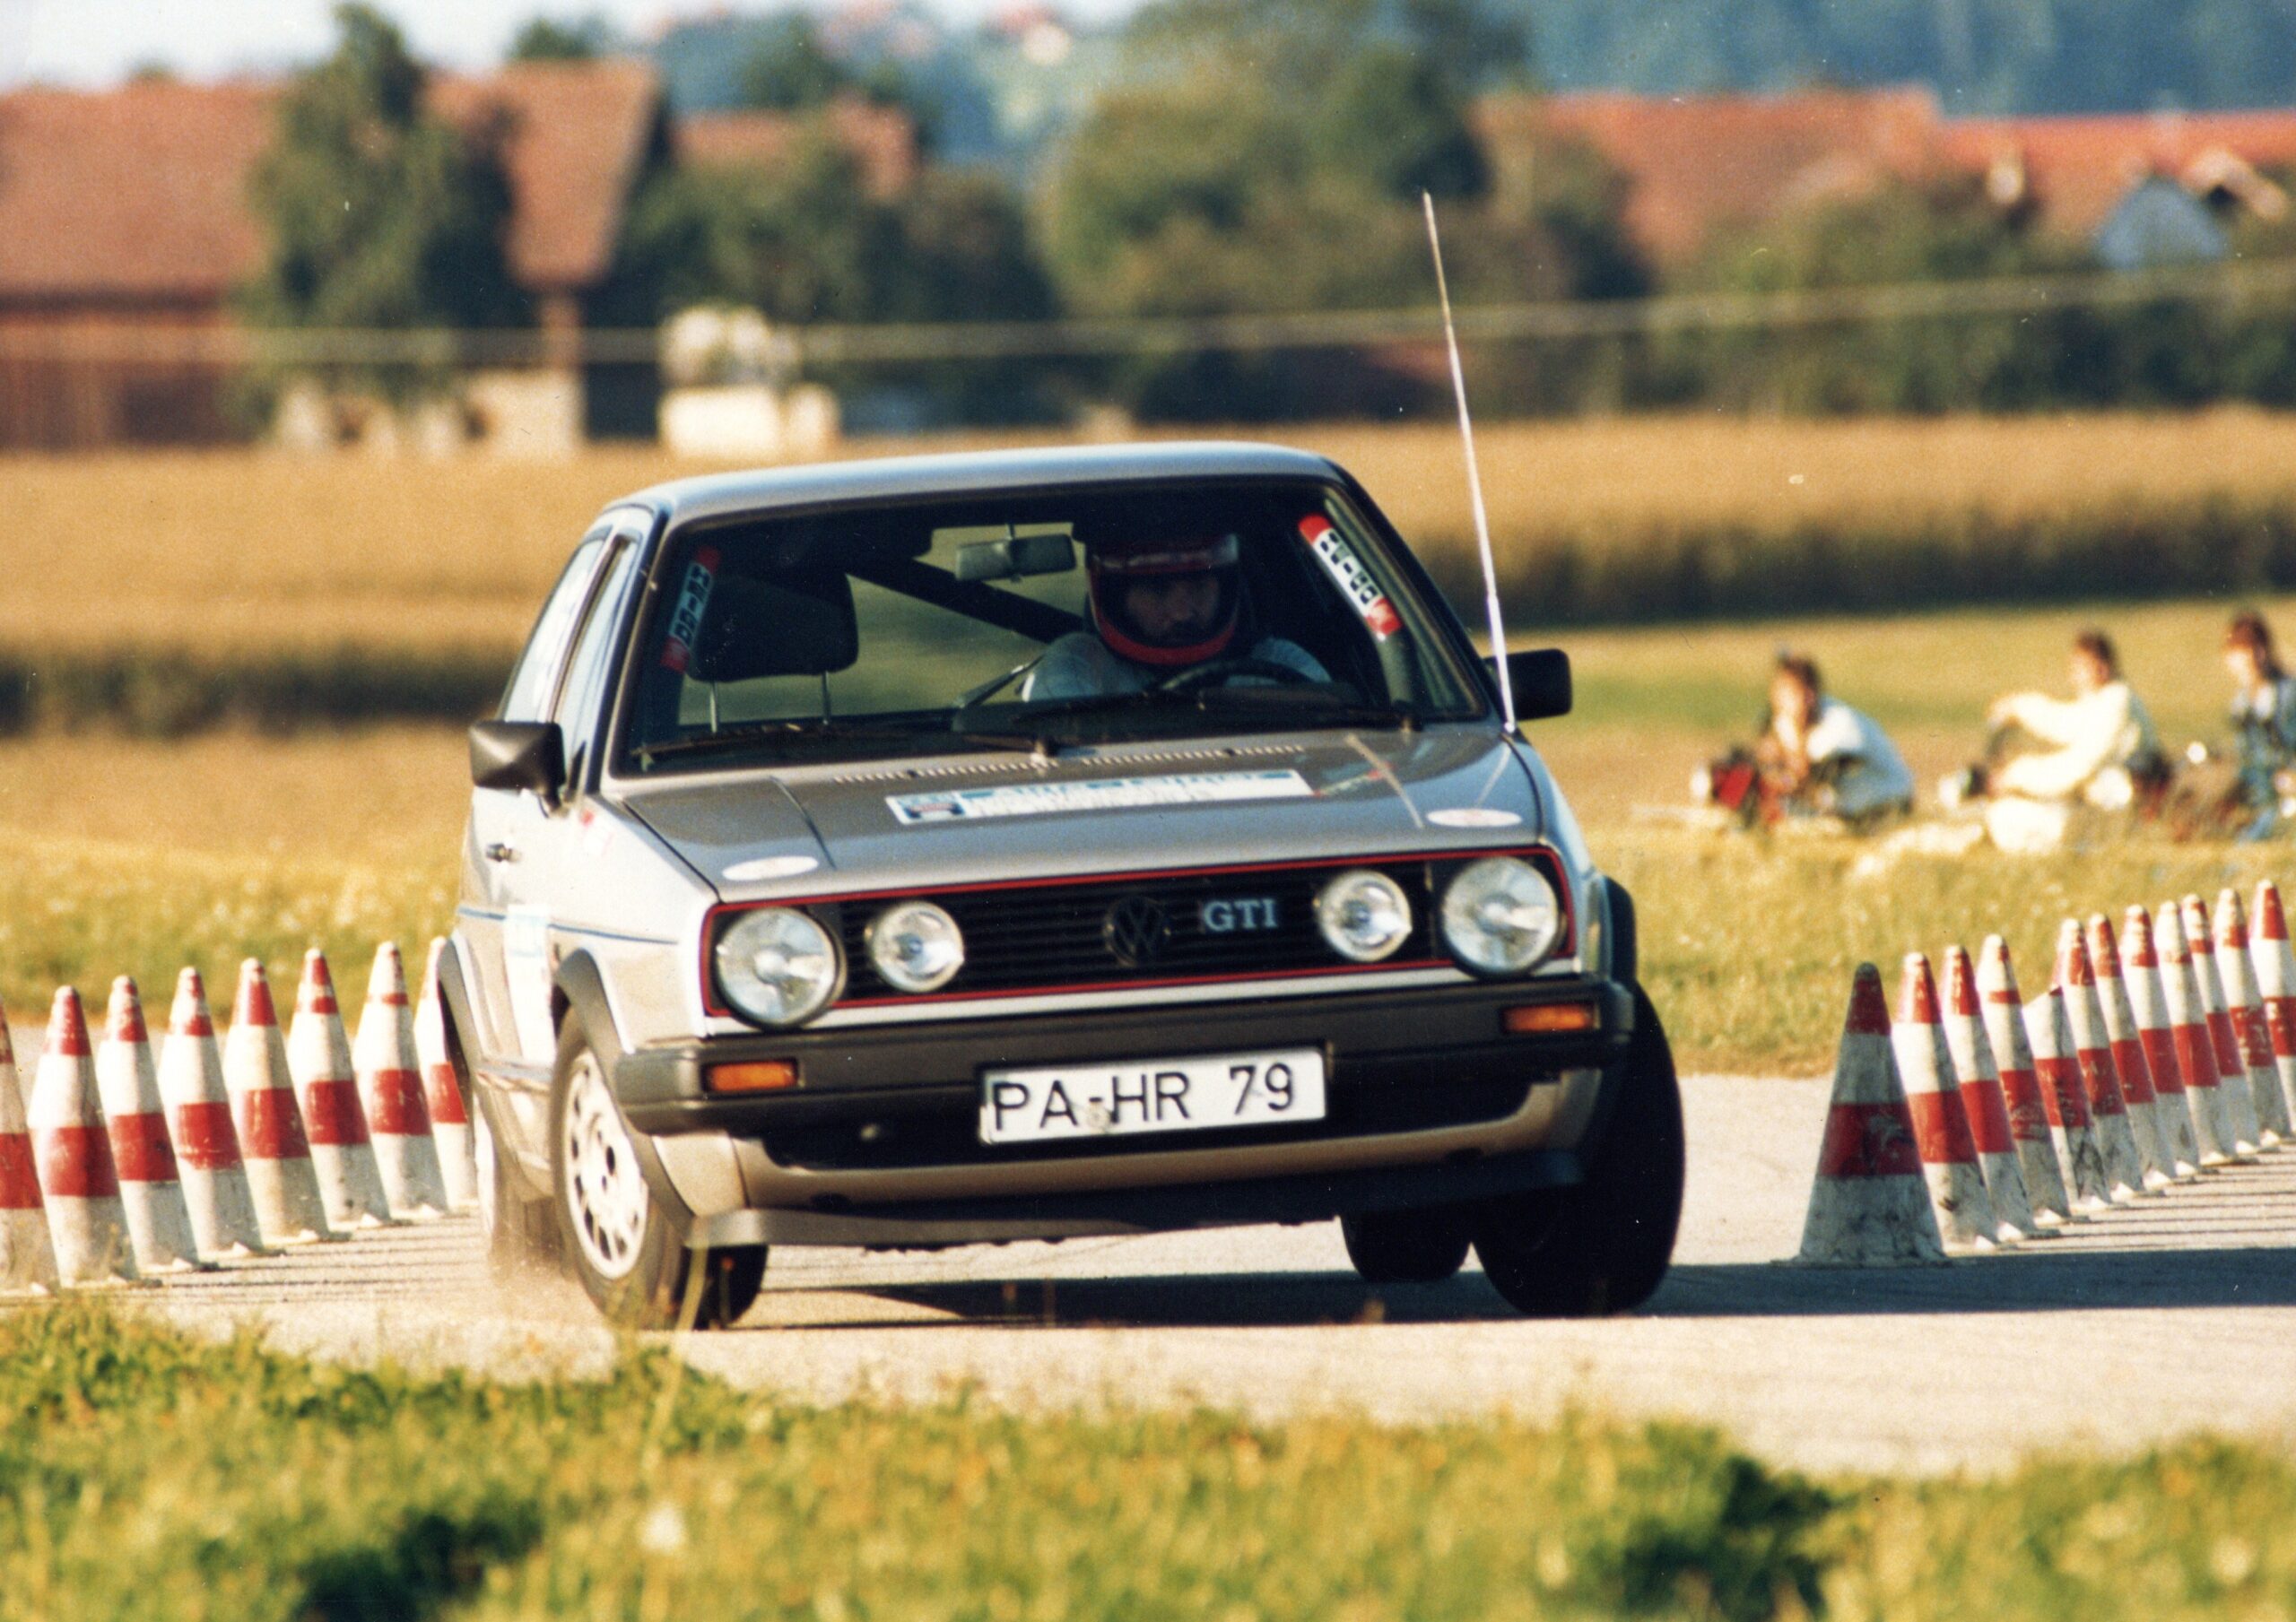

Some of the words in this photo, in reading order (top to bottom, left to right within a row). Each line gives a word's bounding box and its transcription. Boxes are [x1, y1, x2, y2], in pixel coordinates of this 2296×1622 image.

[1203, 898, 1278, 932] GTI
[992, 1071, 1191, 1132] PA-HR
[1228, 1062, 1295, 1117] 79
